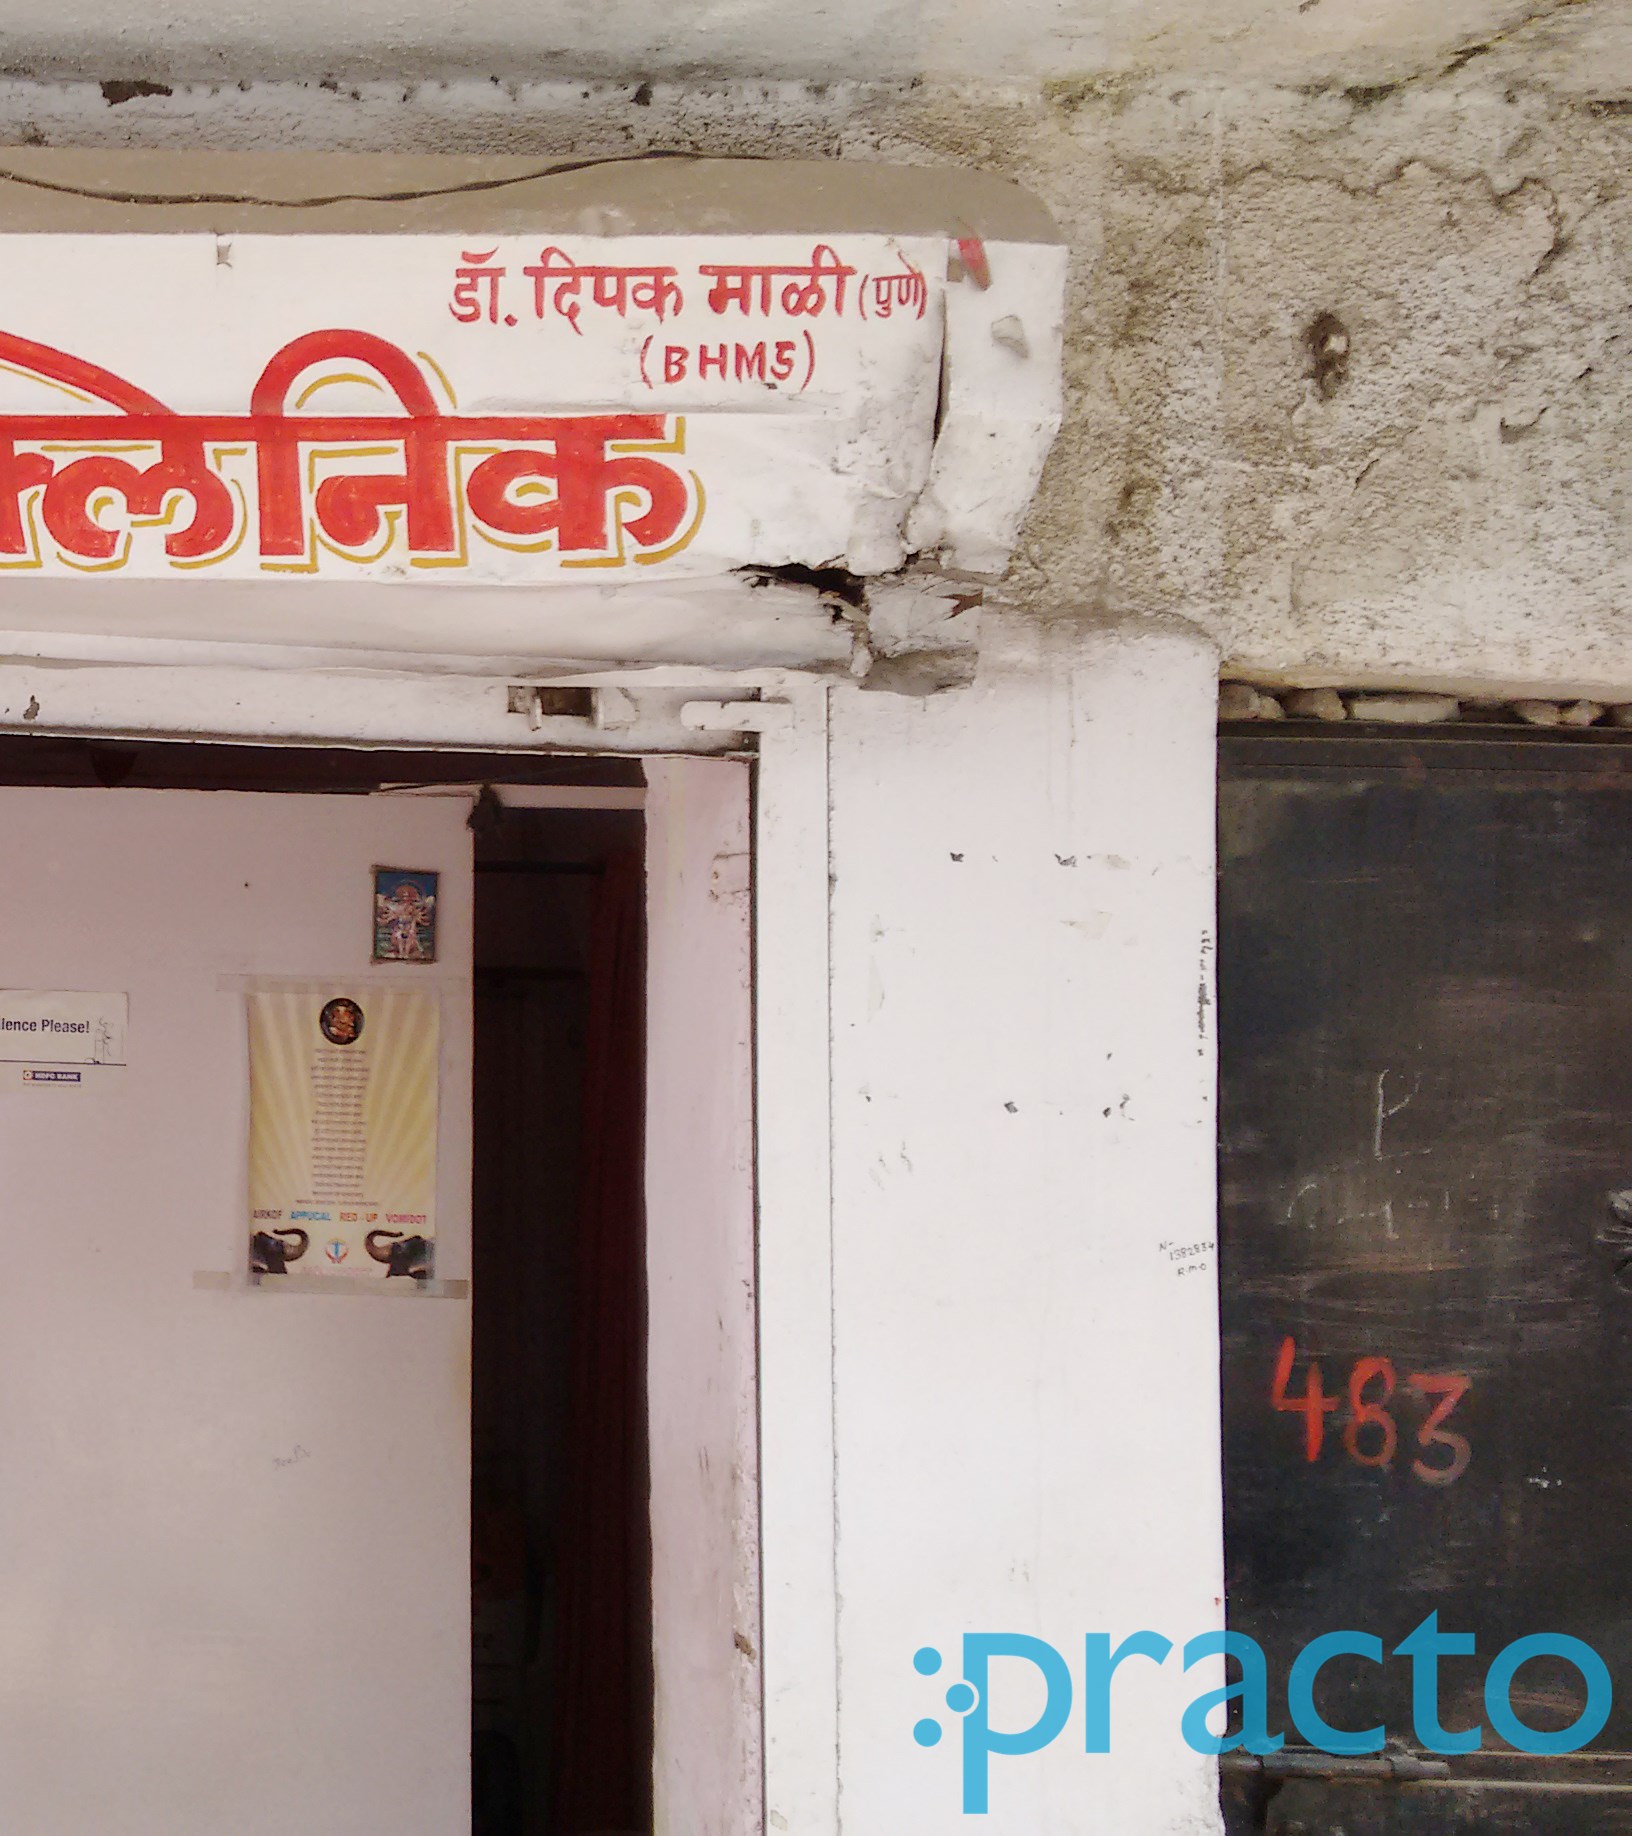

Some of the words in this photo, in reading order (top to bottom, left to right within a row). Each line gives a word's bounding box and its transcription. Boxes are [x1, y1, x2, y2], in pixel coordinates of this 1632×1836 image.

[448, 247, 518, 327] डॉ.
[522, 245, 685, 336] दिपक
[698, 243, 858, 318] माळी
[41, 1019, 90, 1033] Please!
[1270, 1336, 1472, 1485] 483
